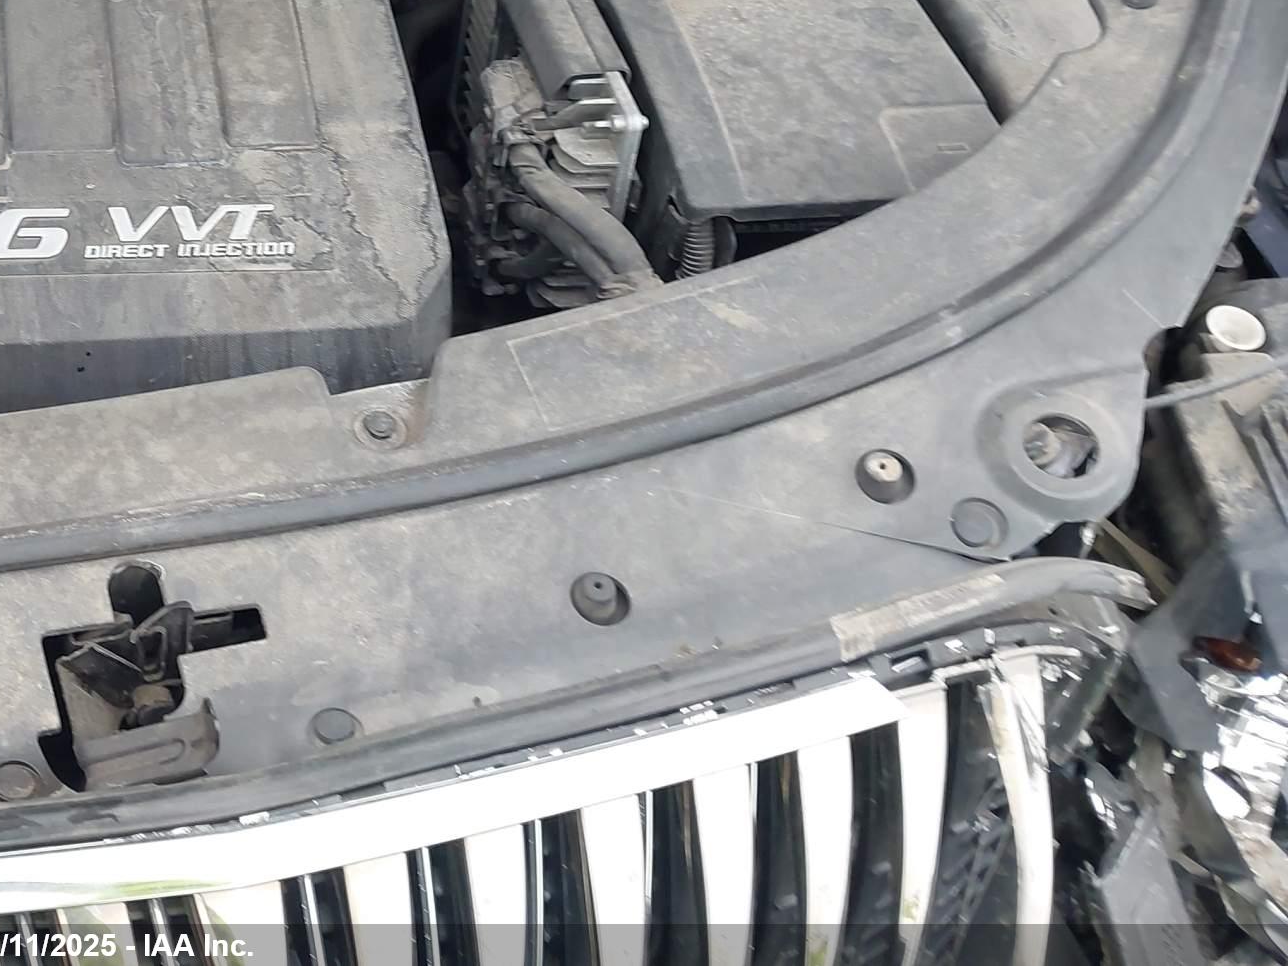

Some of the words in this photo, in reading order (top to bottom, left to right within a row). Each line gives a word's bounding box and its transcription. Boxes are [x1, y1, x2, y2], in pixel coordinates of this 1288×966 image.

[108, 203, 275, 242] VVT
[84, 243, 170, 259] DIRECT
[176, 241, 296, 258] INJECTION
